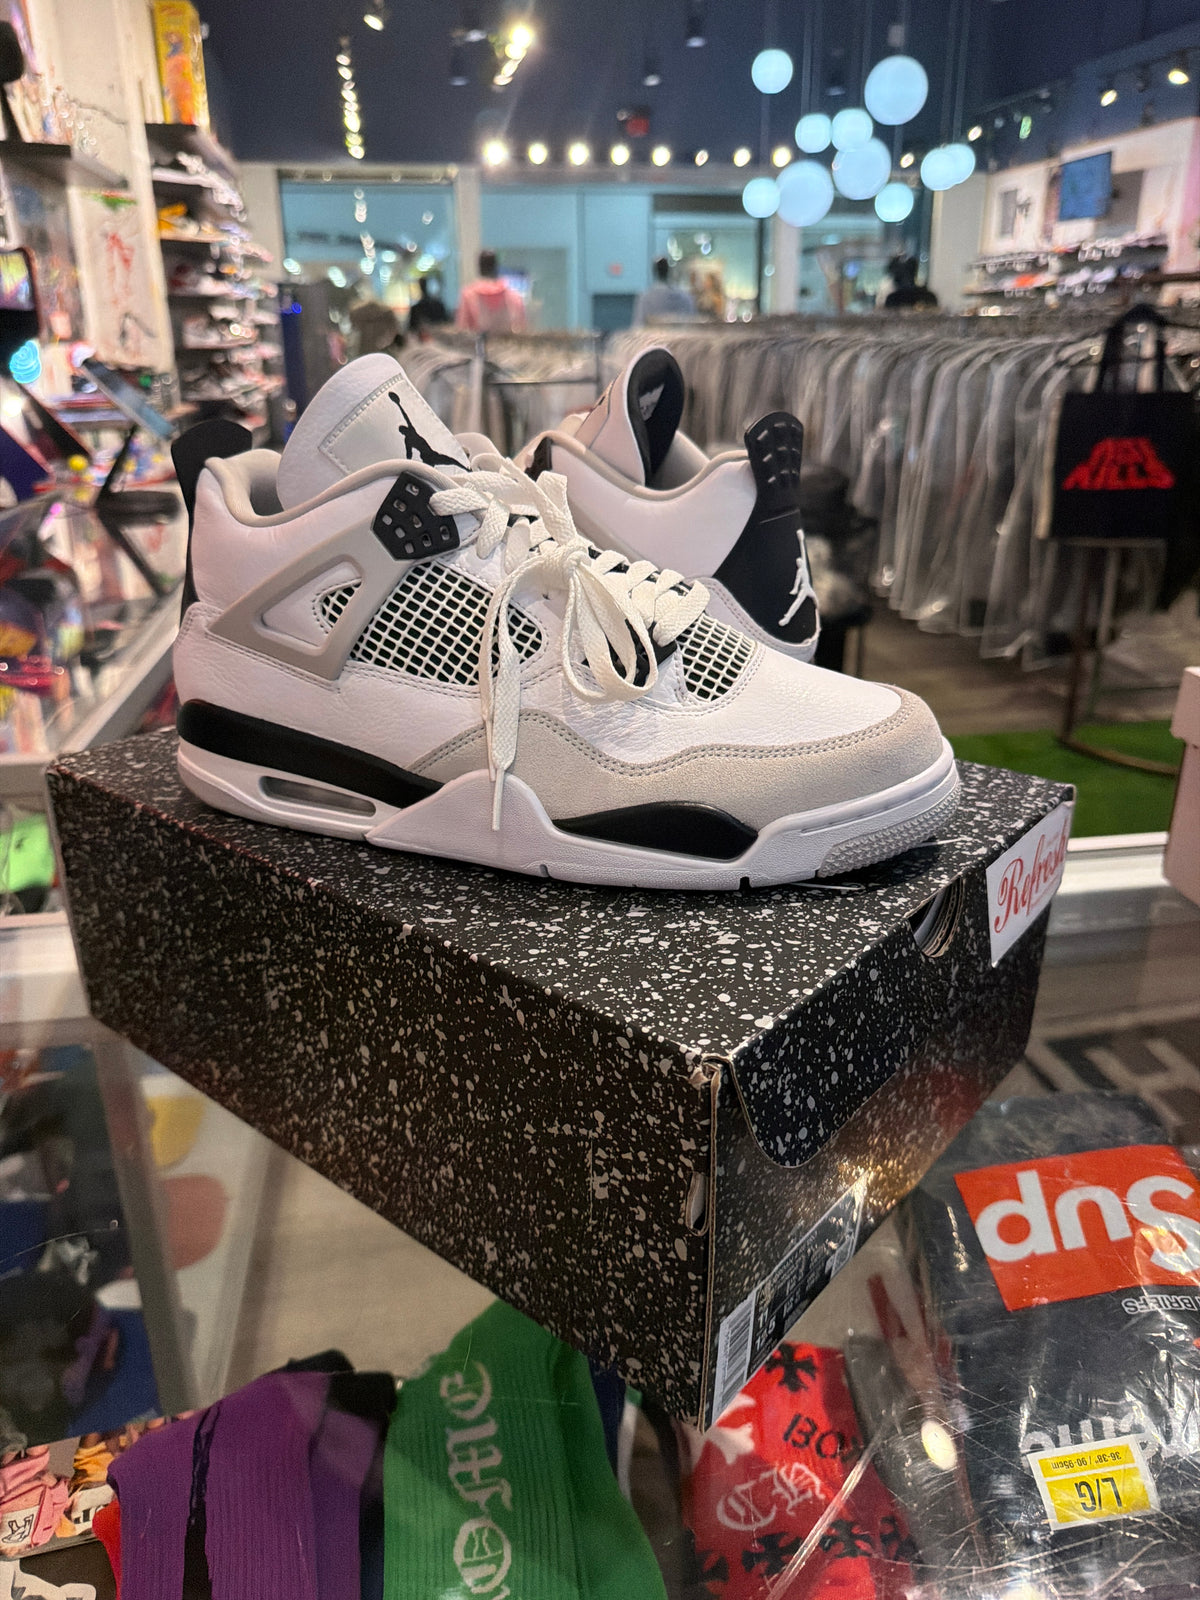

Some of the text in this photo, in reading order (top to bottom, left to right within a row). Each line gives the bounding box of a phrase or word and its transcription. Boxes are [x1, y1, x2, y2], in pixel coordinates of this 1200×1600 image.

[975, 1170, 1200, 1273] Sup
[1121, 1294, 1198, 1315] BRIEFS
[1051, 1457, 1088, 1470] 90-95cm
[1074, 1476, 1123, 1513] L/G
